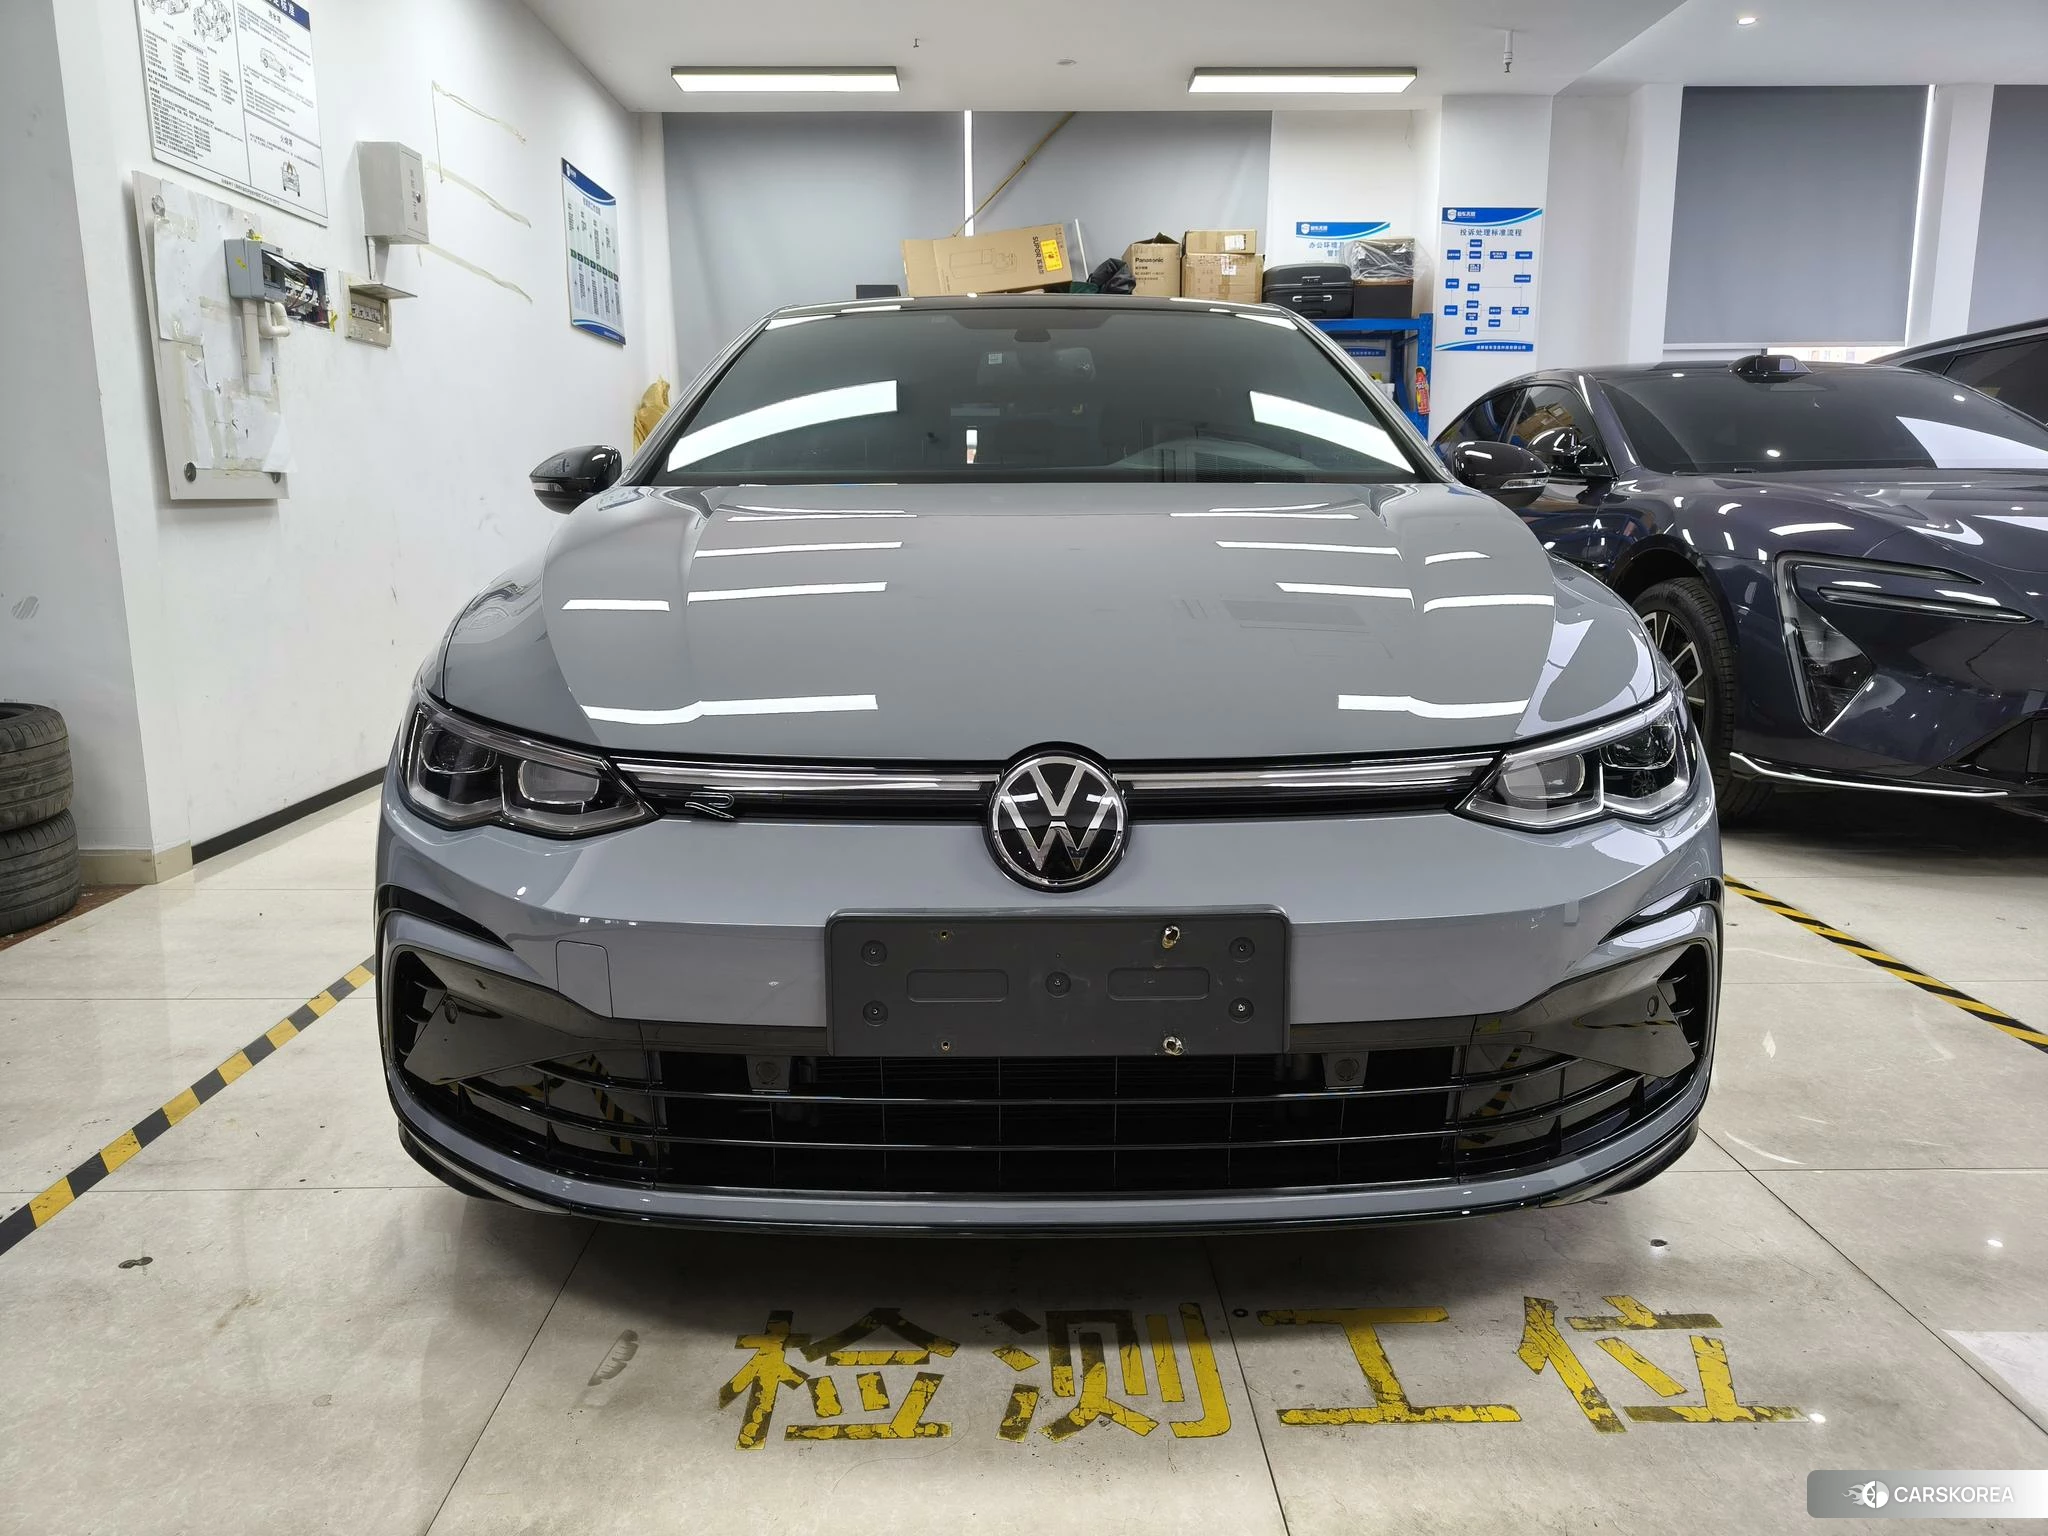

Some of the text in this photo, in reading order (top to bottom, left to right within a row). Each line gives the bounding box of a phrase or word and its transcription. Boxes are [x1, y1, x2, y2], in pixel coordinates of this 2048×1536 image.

[1032, 235, 1042, 258] SUPOR
[718, 1296, 1808, 1450] 检测工位
